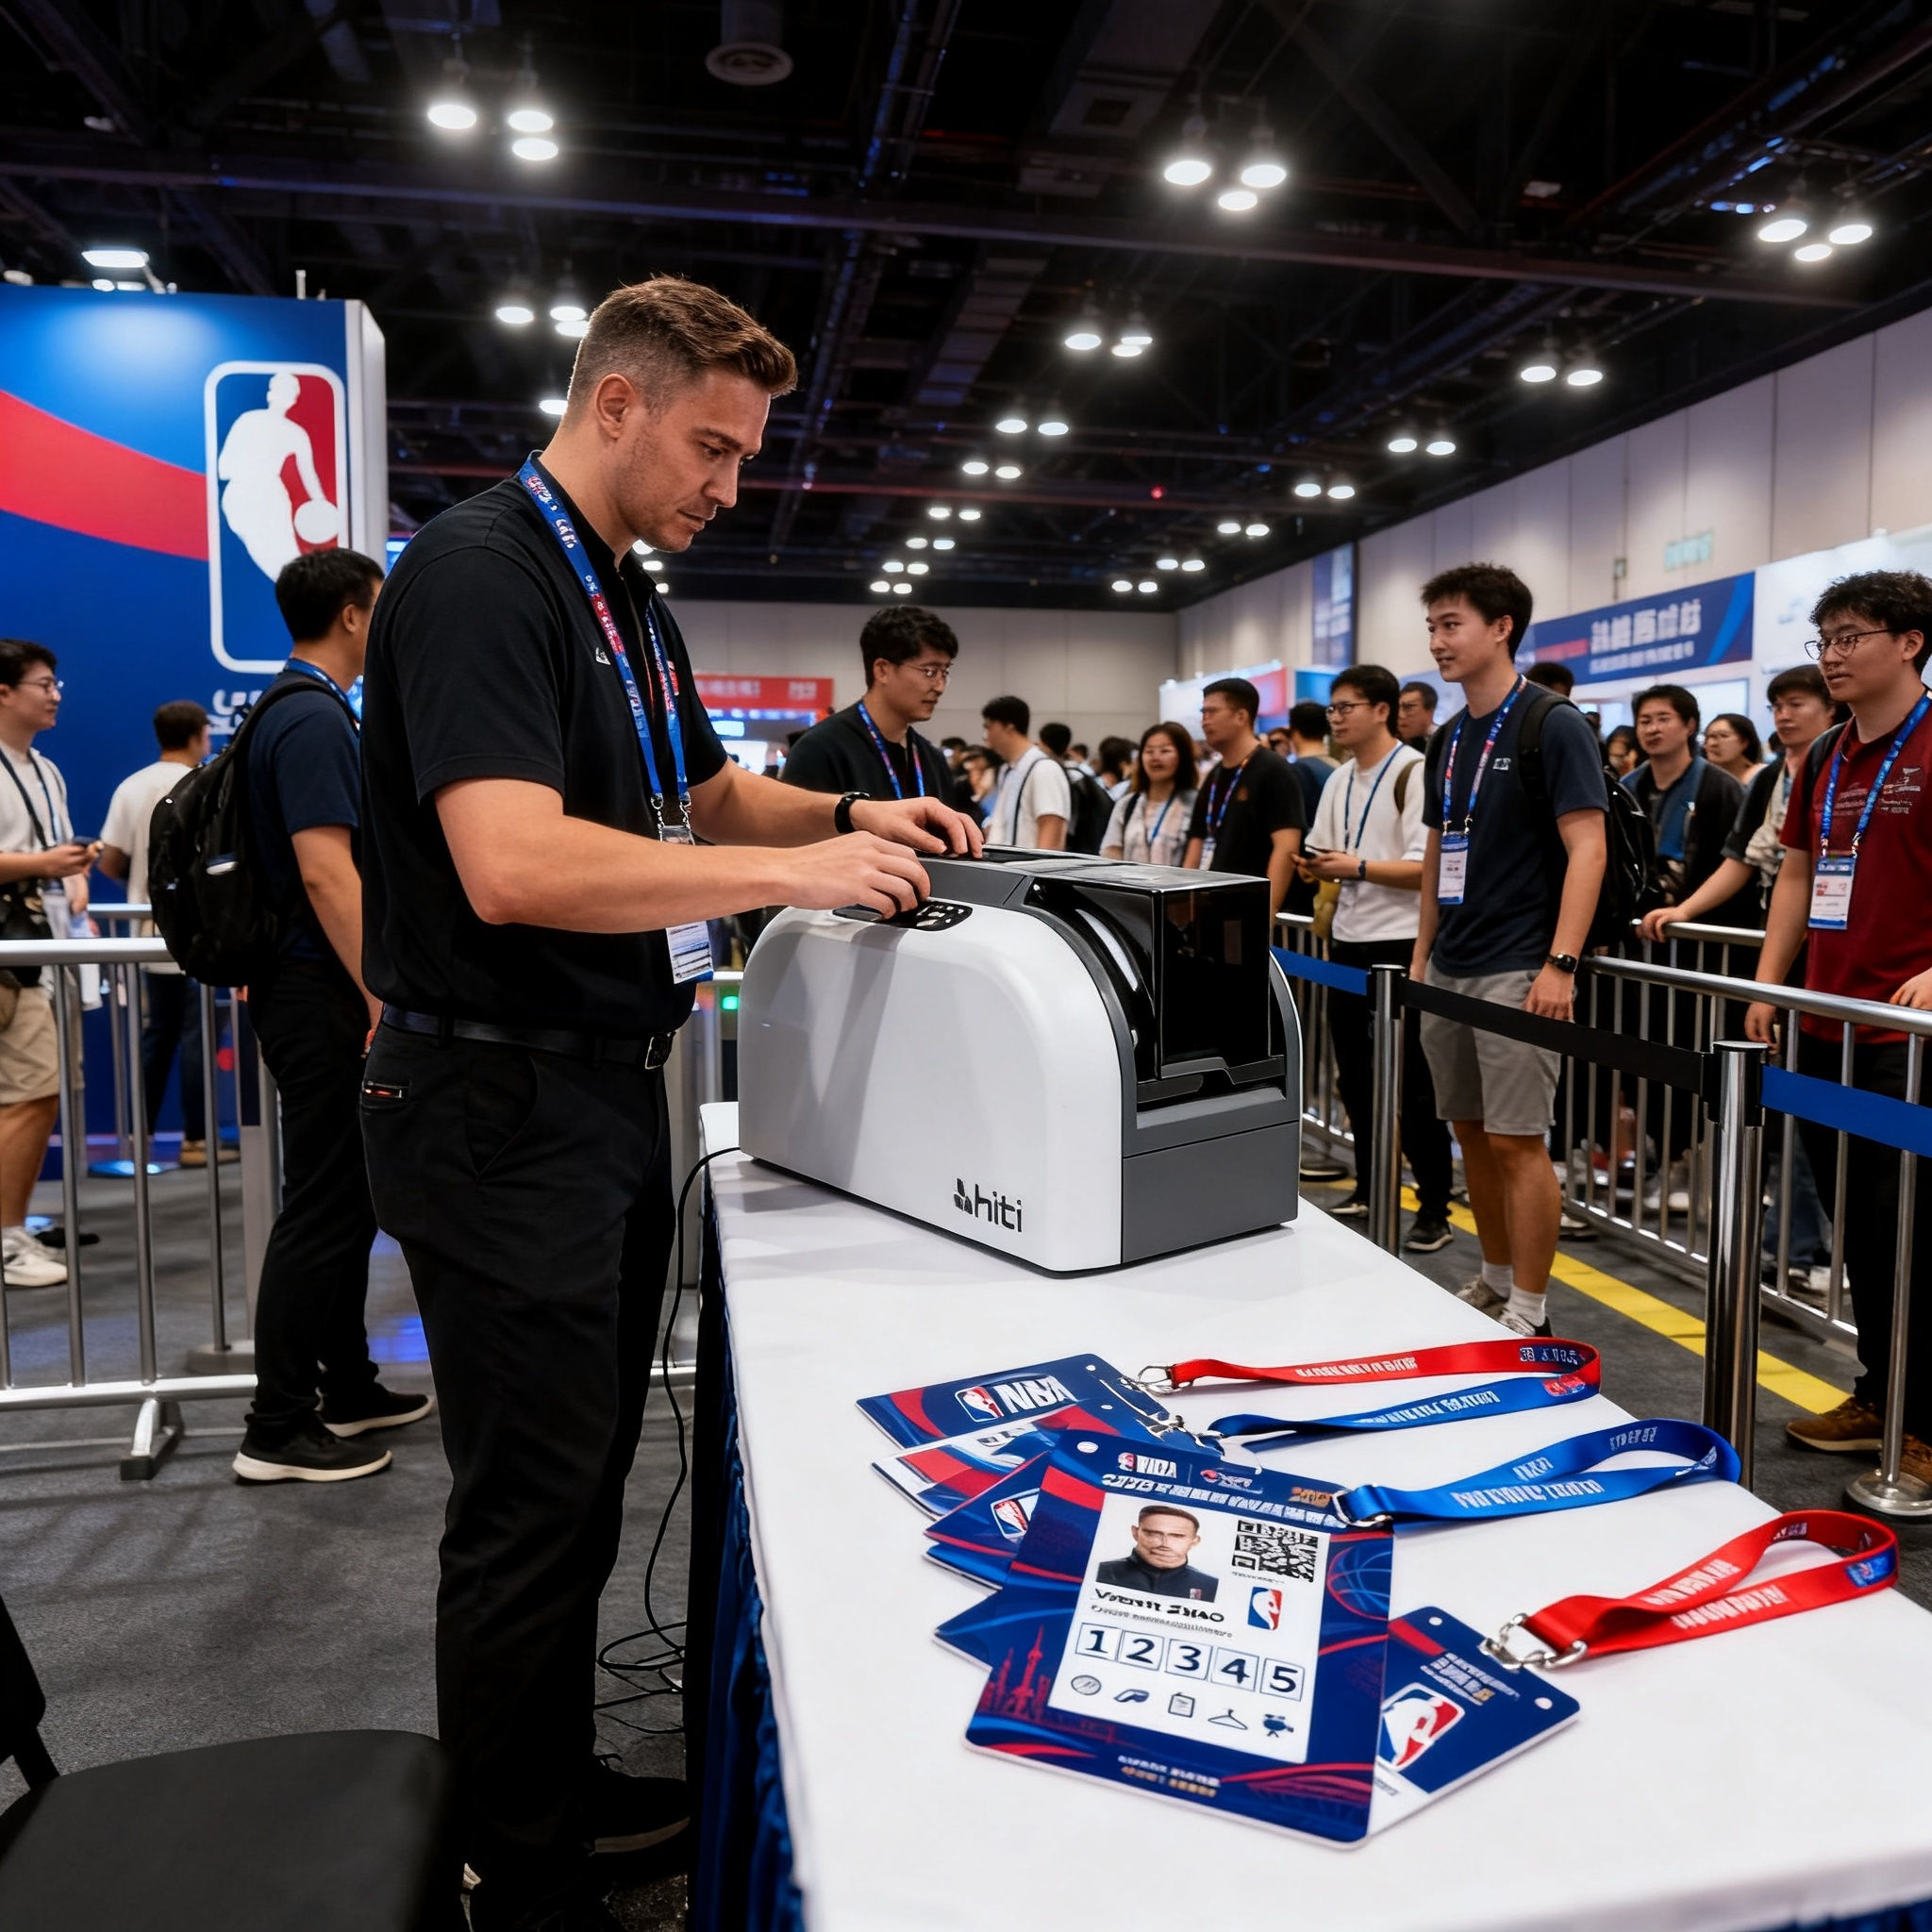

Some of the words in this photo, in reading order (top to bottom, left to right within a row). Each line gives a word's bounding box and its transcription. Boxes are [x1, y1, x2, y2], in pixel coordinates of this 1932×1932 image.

[974, 1183, 1022, 1232] hiti
[1085, 1629, 1108, 1654] 1
[1125, 1638, 1155, 1664] 2
[1174, 1645, 1202, 1672] 3
[1221, 1657, 1250, 1684] 4
[1269, 1665, 1298, 1693] 5
